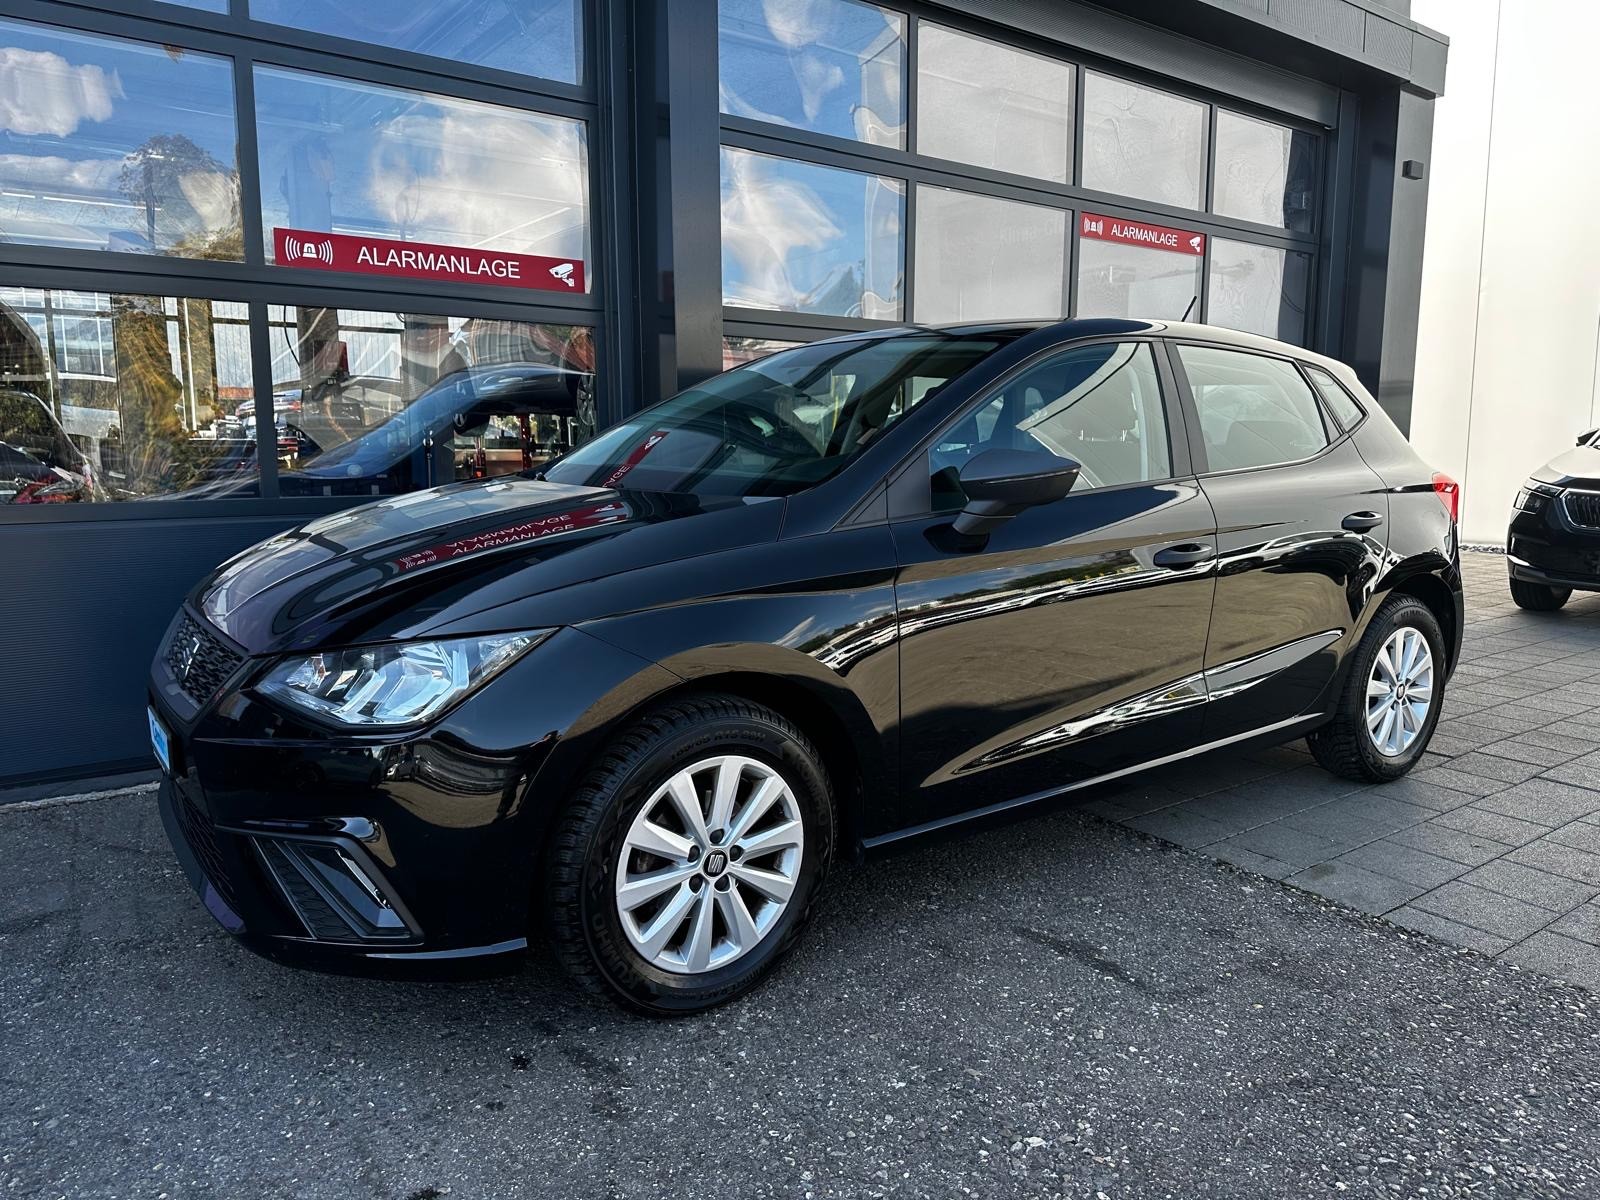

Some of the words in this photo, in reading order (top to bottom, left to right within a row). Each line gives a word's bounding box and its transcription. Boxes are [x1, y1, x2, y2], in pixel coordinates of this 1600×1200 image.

[1110, 223, 1178, 247] ALARMANLAGE
[356, 246, 521, 279] ALARMANLAGE
[452, 523, 575, 556] ALARMANLAGE
